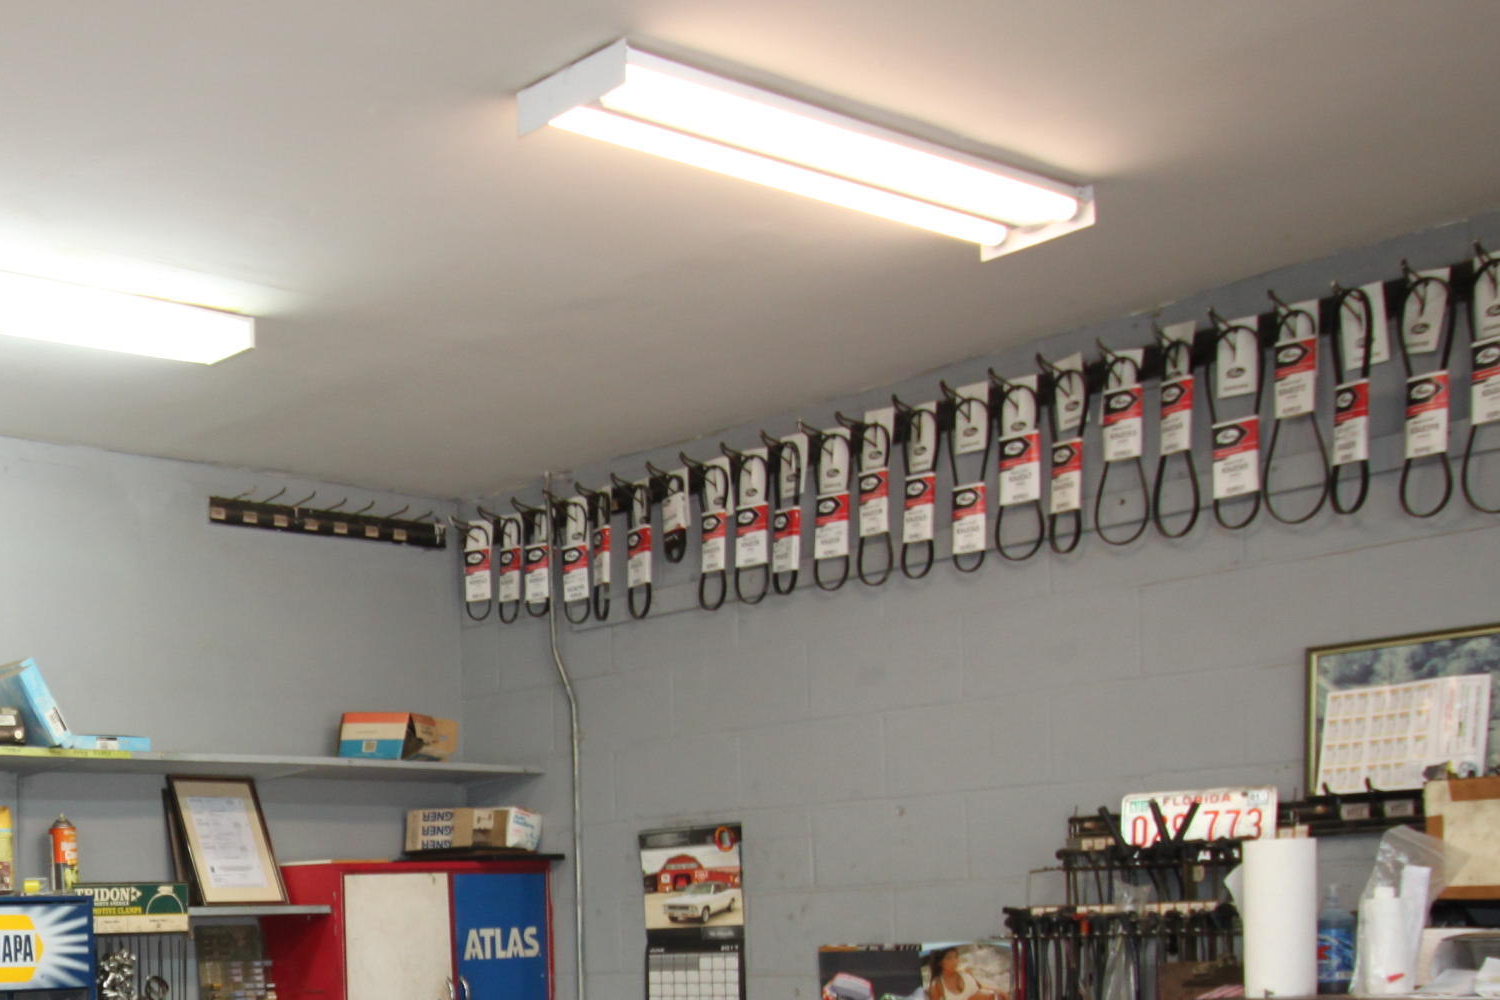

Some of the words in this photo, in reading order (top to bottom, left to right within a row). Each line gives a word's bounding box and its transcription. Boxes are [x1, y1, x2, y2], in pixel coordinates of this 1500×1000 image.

[1162, 793, 1231, 807] FLORIDA
[422, 811, 452, 823] GNER
[1203, 807, 1263, 841] 773
[421, 825, 452, 837] GNER
[421, 839, 452, 849] GNER
[464, 926, 540, 960] ATLAS
